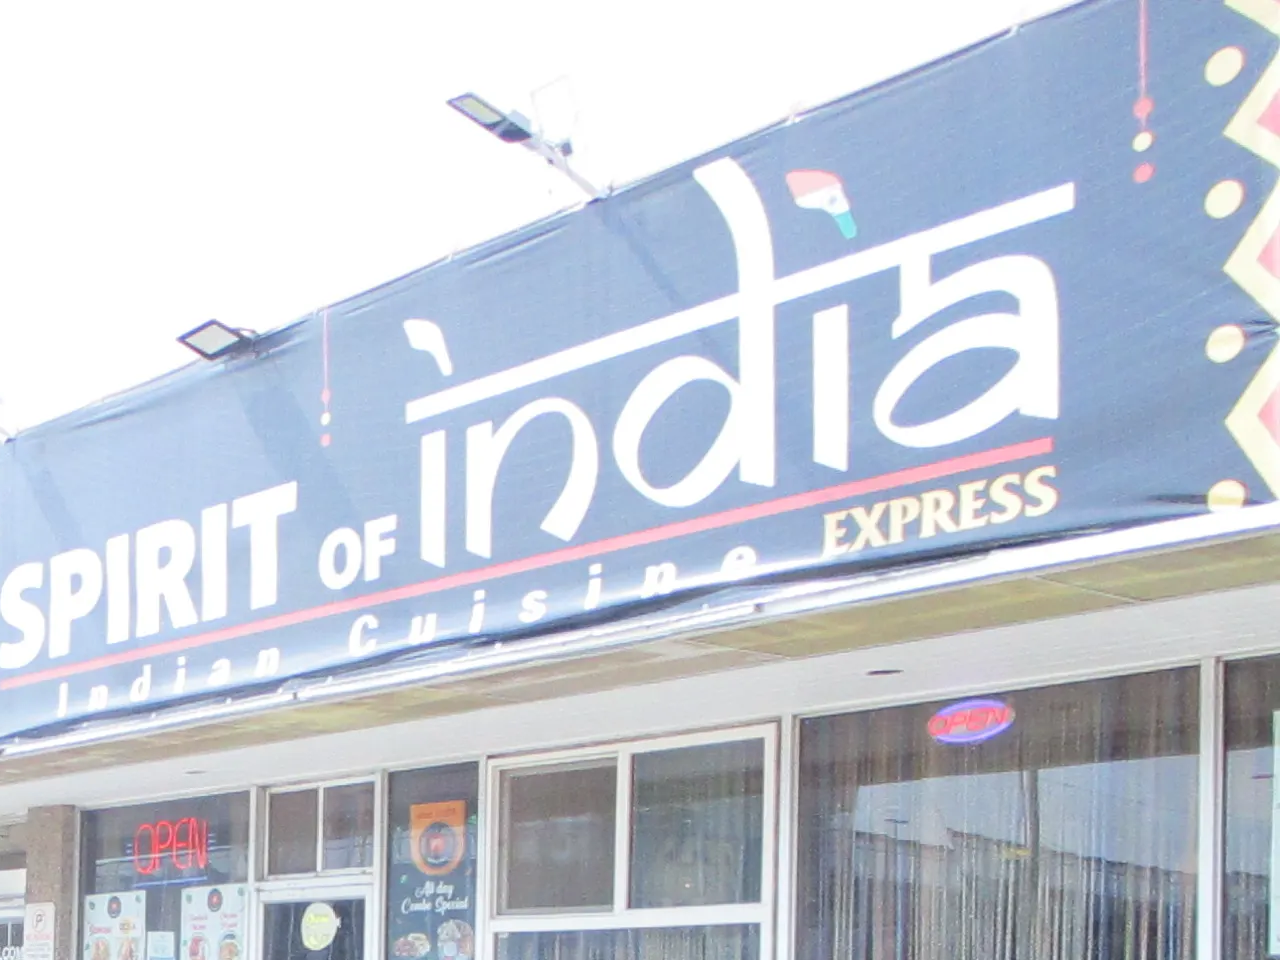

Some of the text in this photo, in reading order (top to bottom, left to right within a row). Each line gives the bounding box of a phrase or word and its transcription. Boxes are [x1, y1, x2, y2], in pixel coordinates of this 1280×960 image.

[821, 466, 1058, 558] EXPRESS
[0, 481, 297, 670] SPIRIT
[318, 514, 397, 590] OF
[56, 546, 758, 718] Indian Cuisine
[928, 706, 1009, 736] OPEN
[134, 817, 207, 875] OPEN
